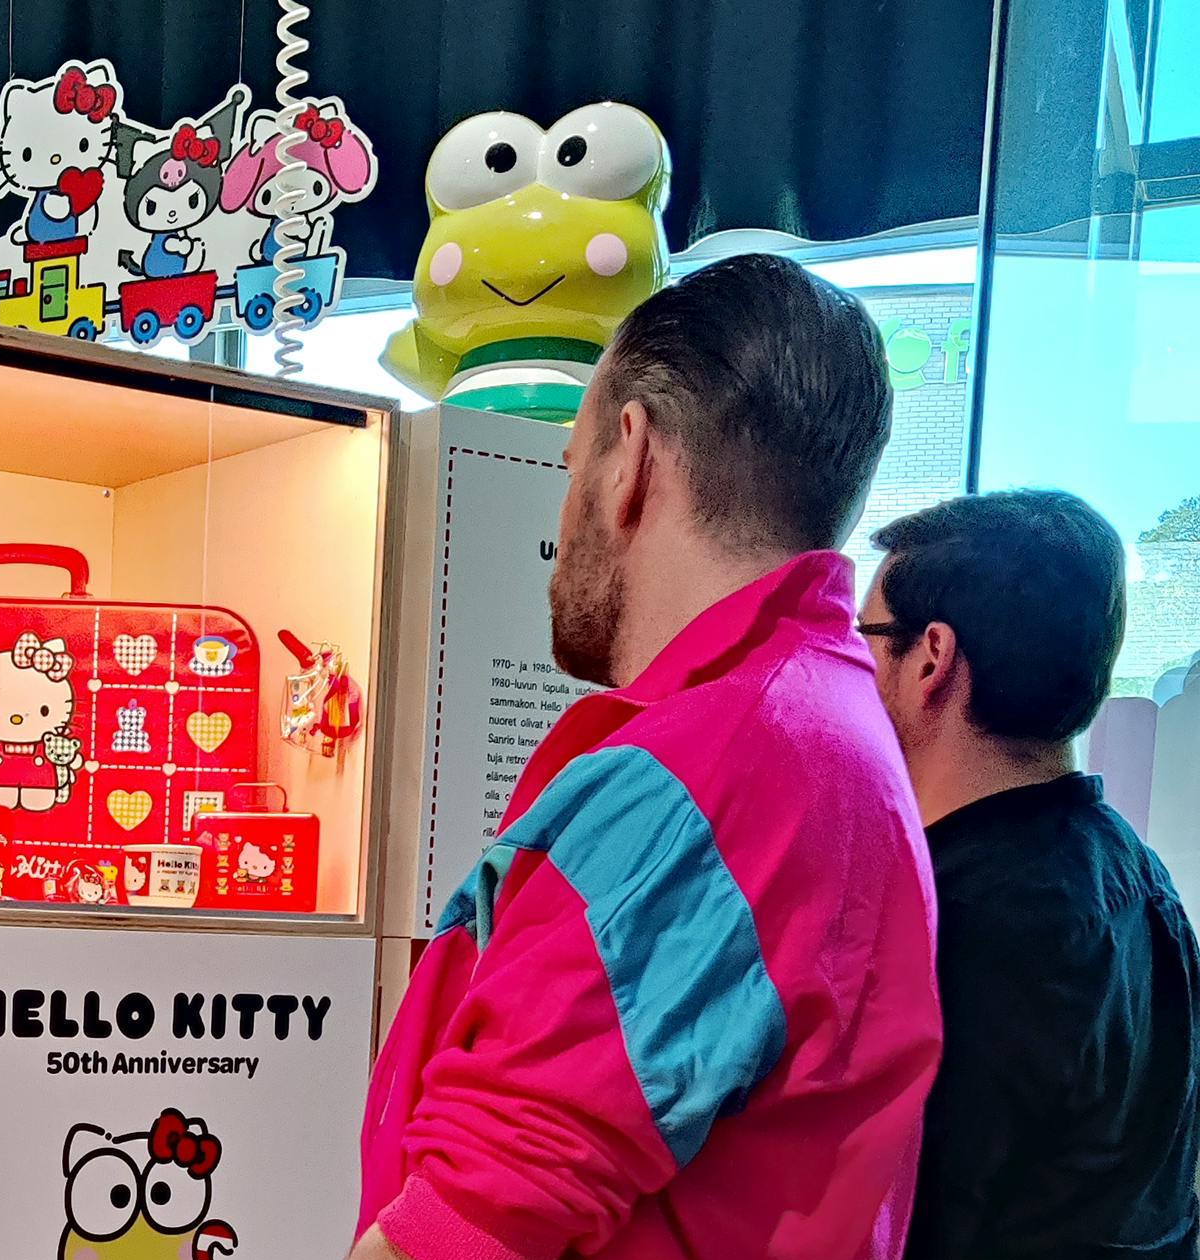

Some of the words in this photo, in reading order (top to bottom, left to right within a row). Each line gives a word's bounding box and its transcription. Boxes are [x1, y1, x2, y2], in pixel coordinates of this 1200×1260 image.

[492, 658, 515, 669] 1970-
[519, 661, 527, 673] ja
[491, 677, 537, 690] 1980-luvun
[543, 682, 570, 694] lopulla
[490, 697, 537, 709] sammakon.
[540, 701, 561, 711] Hello
[489, 716, 517, 727] nuoret
[520, 718, 543, 729] olivat
[488, 733, 515, 745] Sanrio
[518, 736, 539, 747] lanse
[487, 753, 503, 766] tuja
[506, 756, 529, 764] retro
[485, 790, 500, 800] olla
[157, 859, 183, 869] Hello
[172, 992, 332, 1041] KITTY
[47, 1050, 108, 1075] 50th
[111, 1050, 260, 1079] Anniversary
